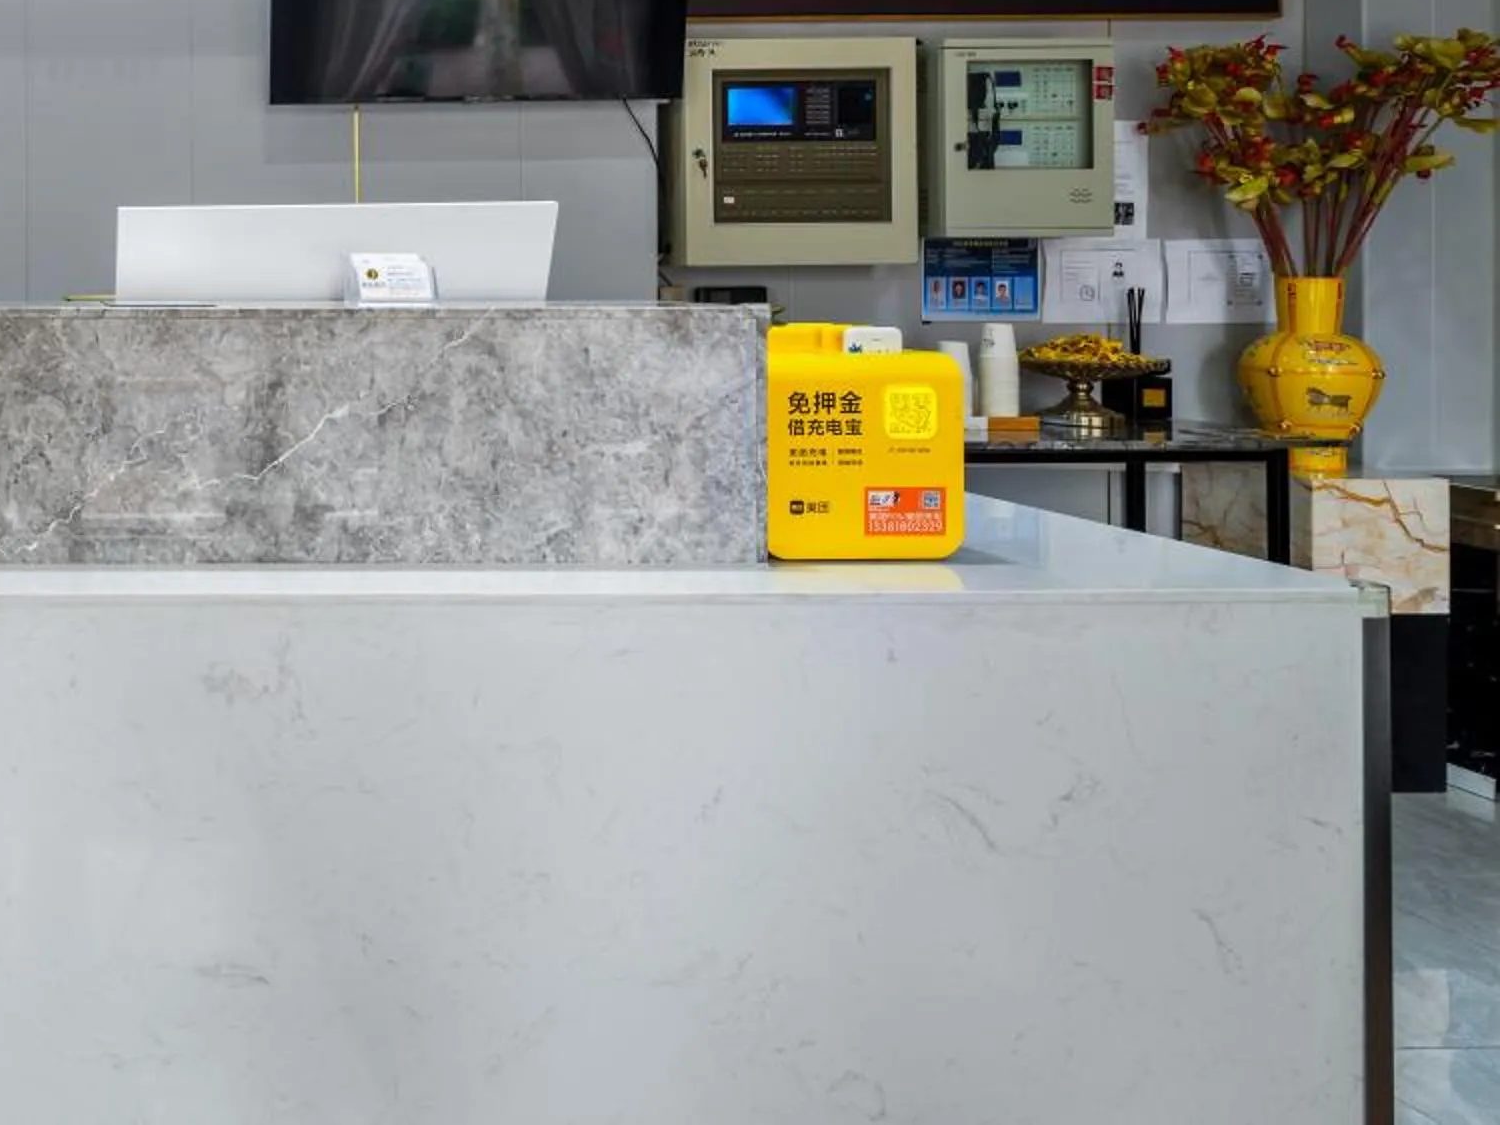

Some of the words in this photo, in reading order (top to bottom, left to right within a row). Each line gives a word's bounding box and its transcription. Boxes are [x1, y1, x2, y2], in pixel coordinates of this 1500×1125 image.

[788, 390, 863, 415] 免押金
[787, 418, 863, 436] 借充电宝
